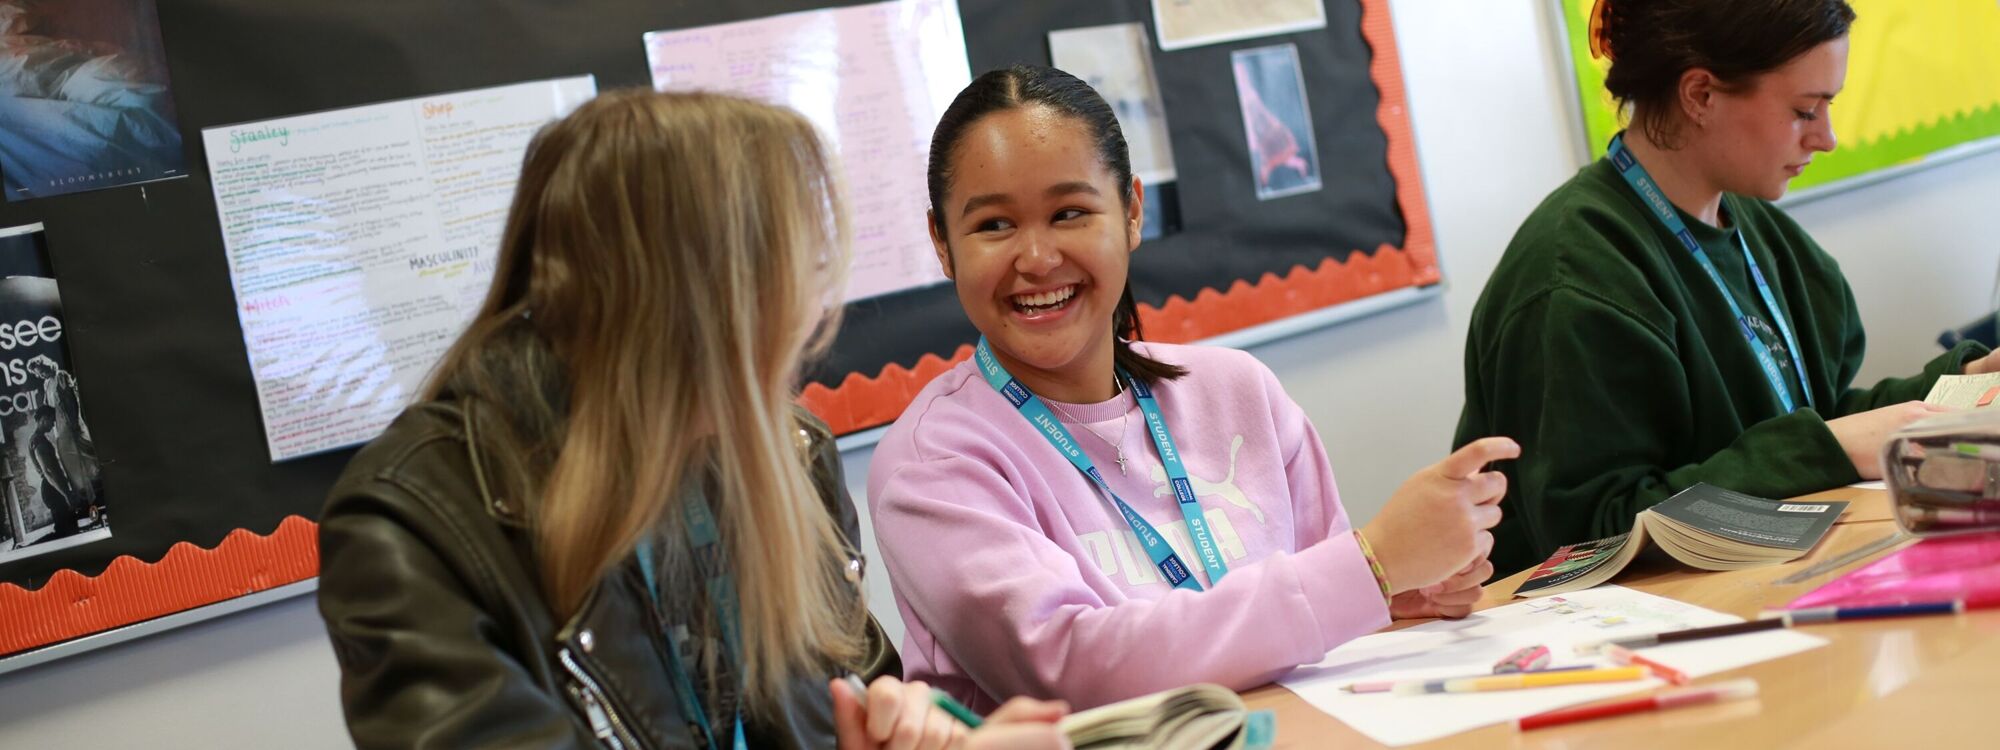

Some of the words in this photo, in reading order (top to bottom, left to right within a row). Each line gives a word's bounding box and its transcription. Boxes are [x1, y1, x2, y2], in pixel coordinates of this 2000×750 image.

[230, 126, 290, 153] Stanley
[50, 167, 142, 187] BLOOMSBURY
[1637, 177, 1673, 219] STUDENT
[408, 246, 479, 270] MASCULINITY
[1760, 351, 1786, 396] STUDENT
[1034, 413, 1080, 457] STUDENT
[1149, 412, 1177, 463] STUDENT
[1118, 500, 1158, 548] STUDENT
[1191, 518, 1220, 570] STUDENT
[1169, 556, 1188, 579] COLLEGE
